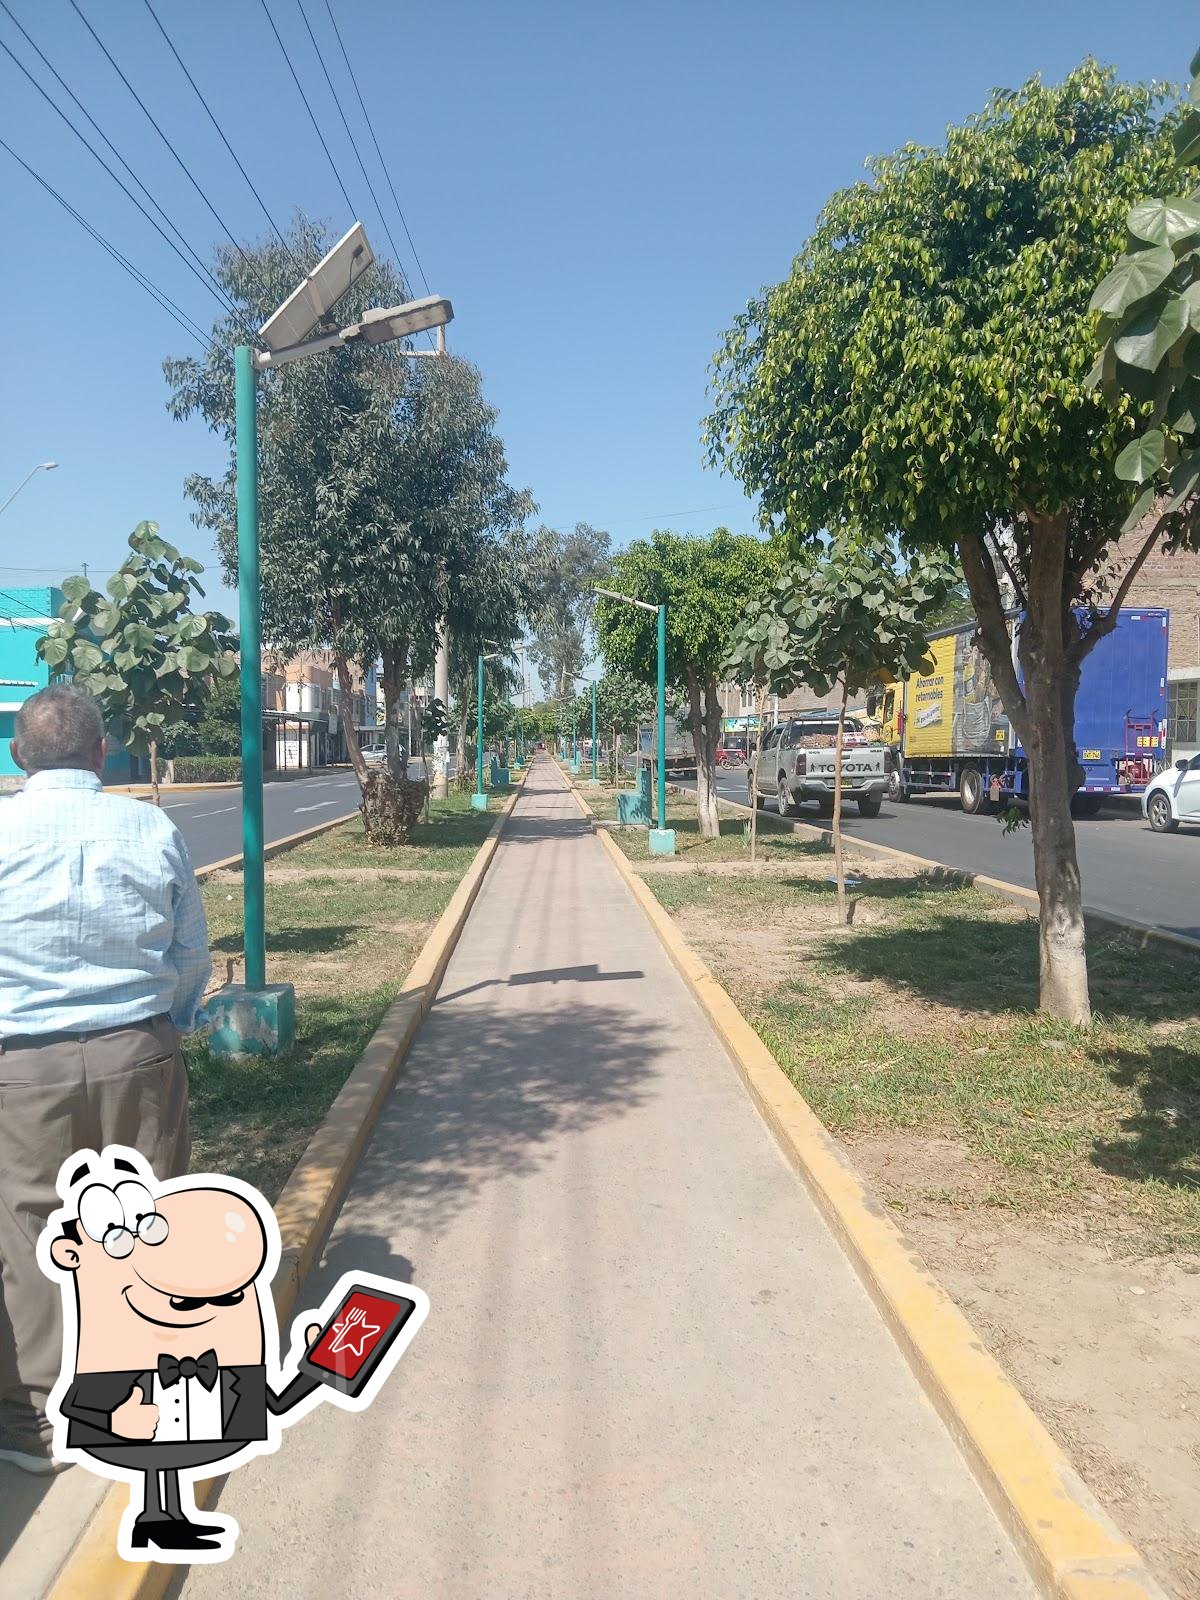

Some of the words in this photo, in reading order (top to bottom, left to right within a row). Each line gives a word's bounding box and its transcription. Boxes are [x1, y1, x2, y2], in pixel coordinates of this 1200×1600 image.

[916, 677, 934, 688] Ahorrar
[935, 676, 944, 685] con
[916, 688, 943, 702] retornables
